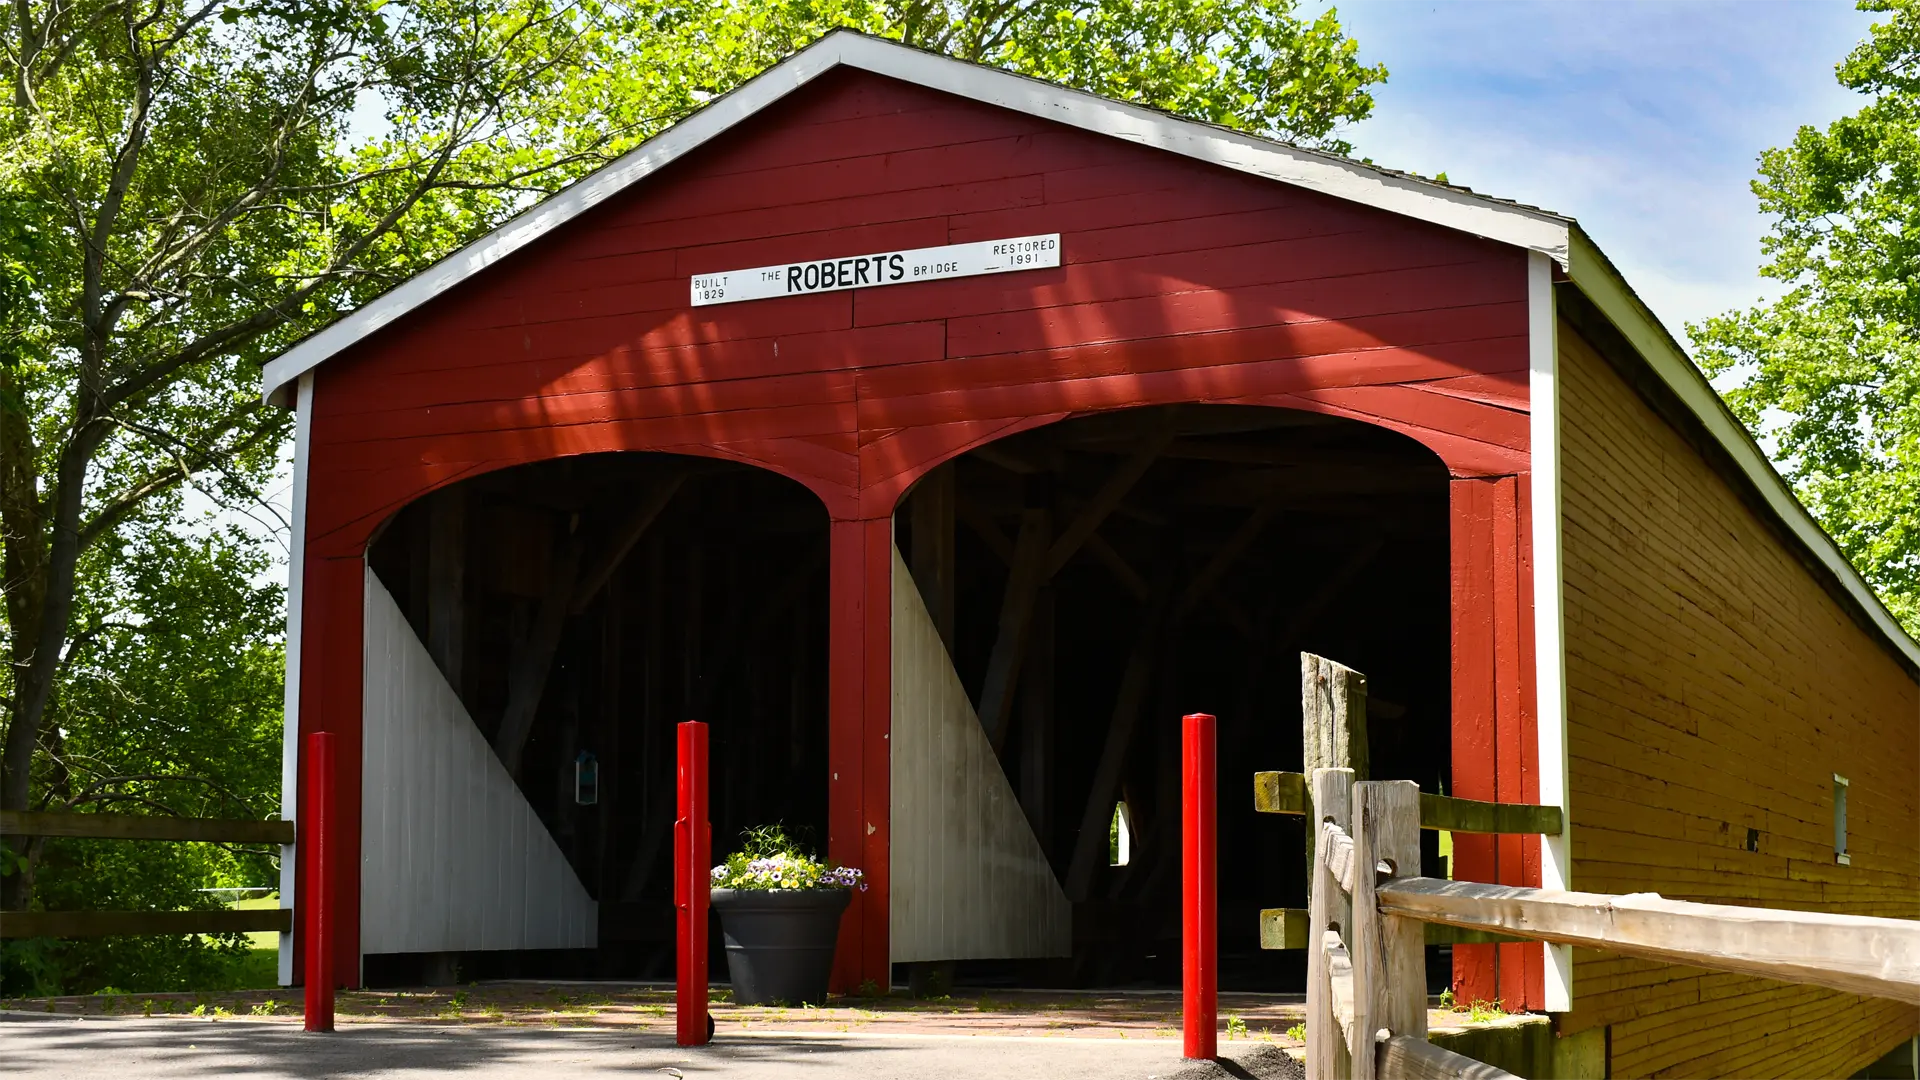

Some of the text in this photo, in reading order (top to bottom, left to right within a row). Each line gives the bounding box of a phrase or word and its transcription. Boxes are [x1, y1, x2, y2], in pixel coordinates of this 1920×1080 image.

[993, 239, 1056, 256] RESTORED
[1010, 253, 1038, 266] 1991
[761, 253, 958, 293] THE ROBERTS BRIDGE
[694, 276, 728, 290] BUILT
[698, 288, 725, 301] 1829
